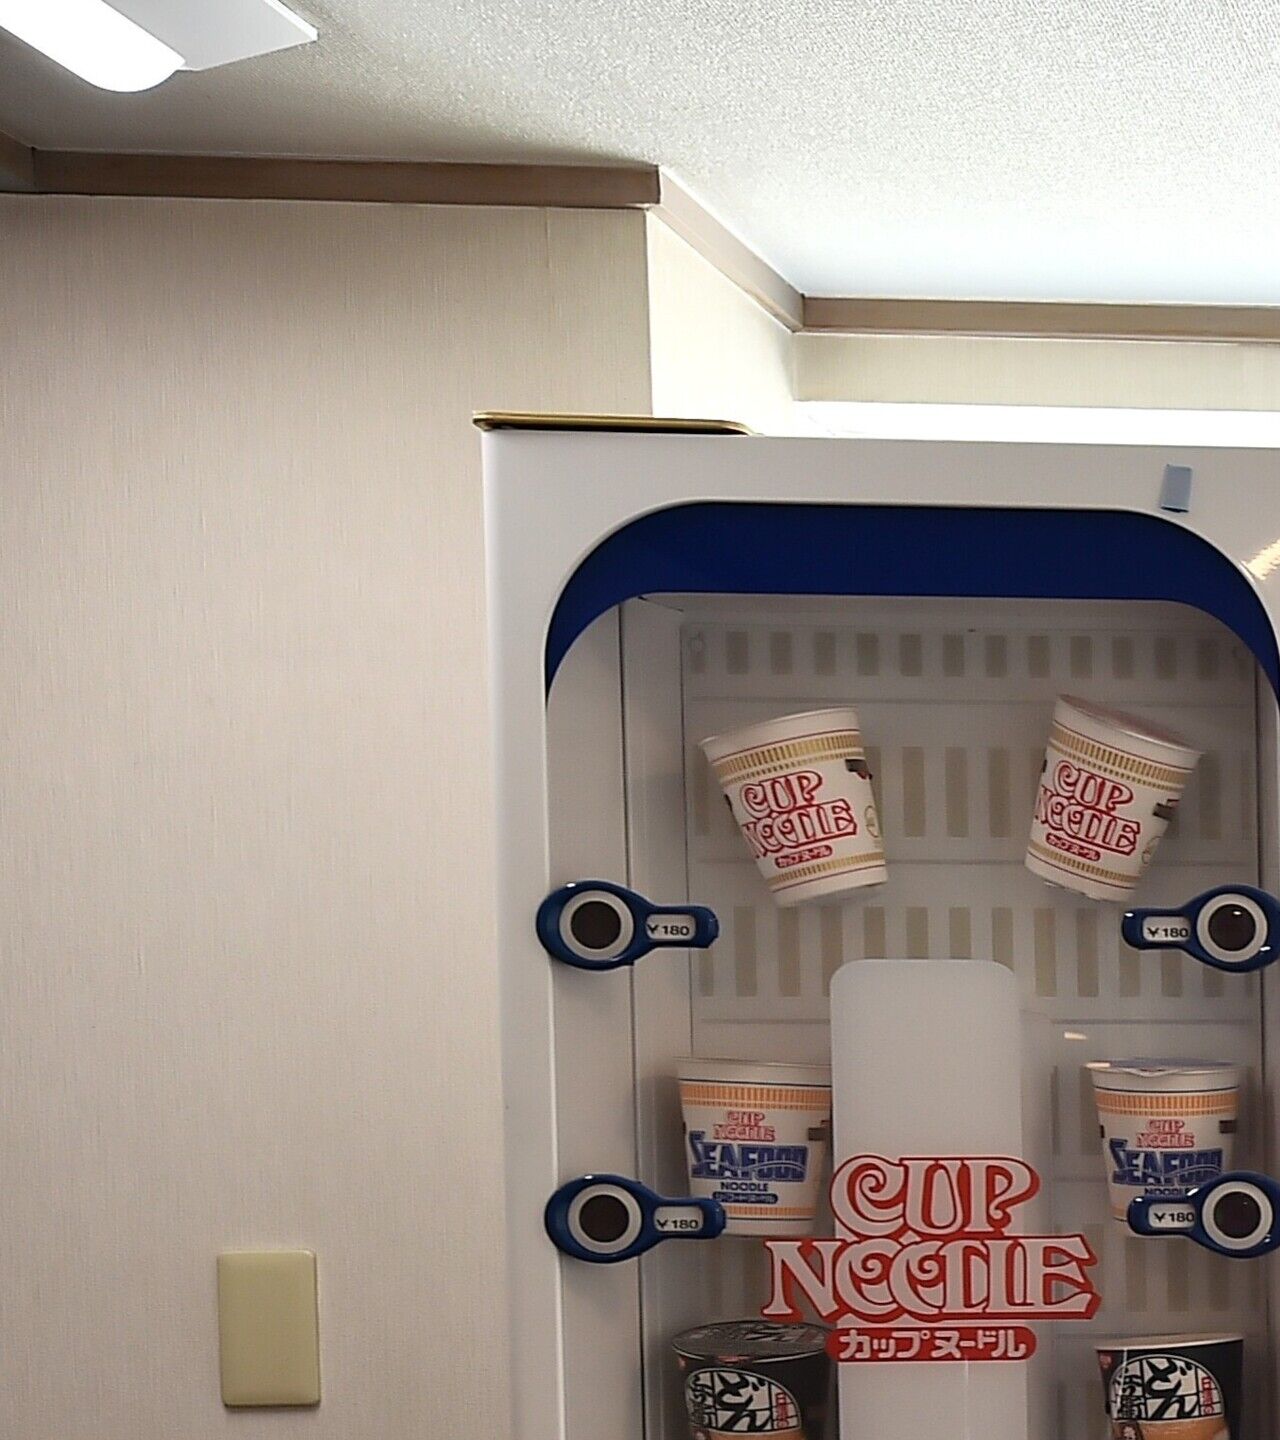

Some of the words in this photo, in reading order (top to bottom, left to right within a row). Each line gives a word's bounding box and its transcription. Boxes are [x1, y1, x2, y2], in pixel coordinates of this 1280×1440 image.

[740, 770, 823, 820] CUP
[1054, 760, 1134, 812] CUP
[689, 1131, 808, 1183] SEAFOOD
[720, 1181, 769, 1192] NOODLE
[830, 1154, 1040, 1242] CUP
[761, 1233, 1102, 1323] NOODLE
[838, 1328, 1027, 1359] カップヌードル
